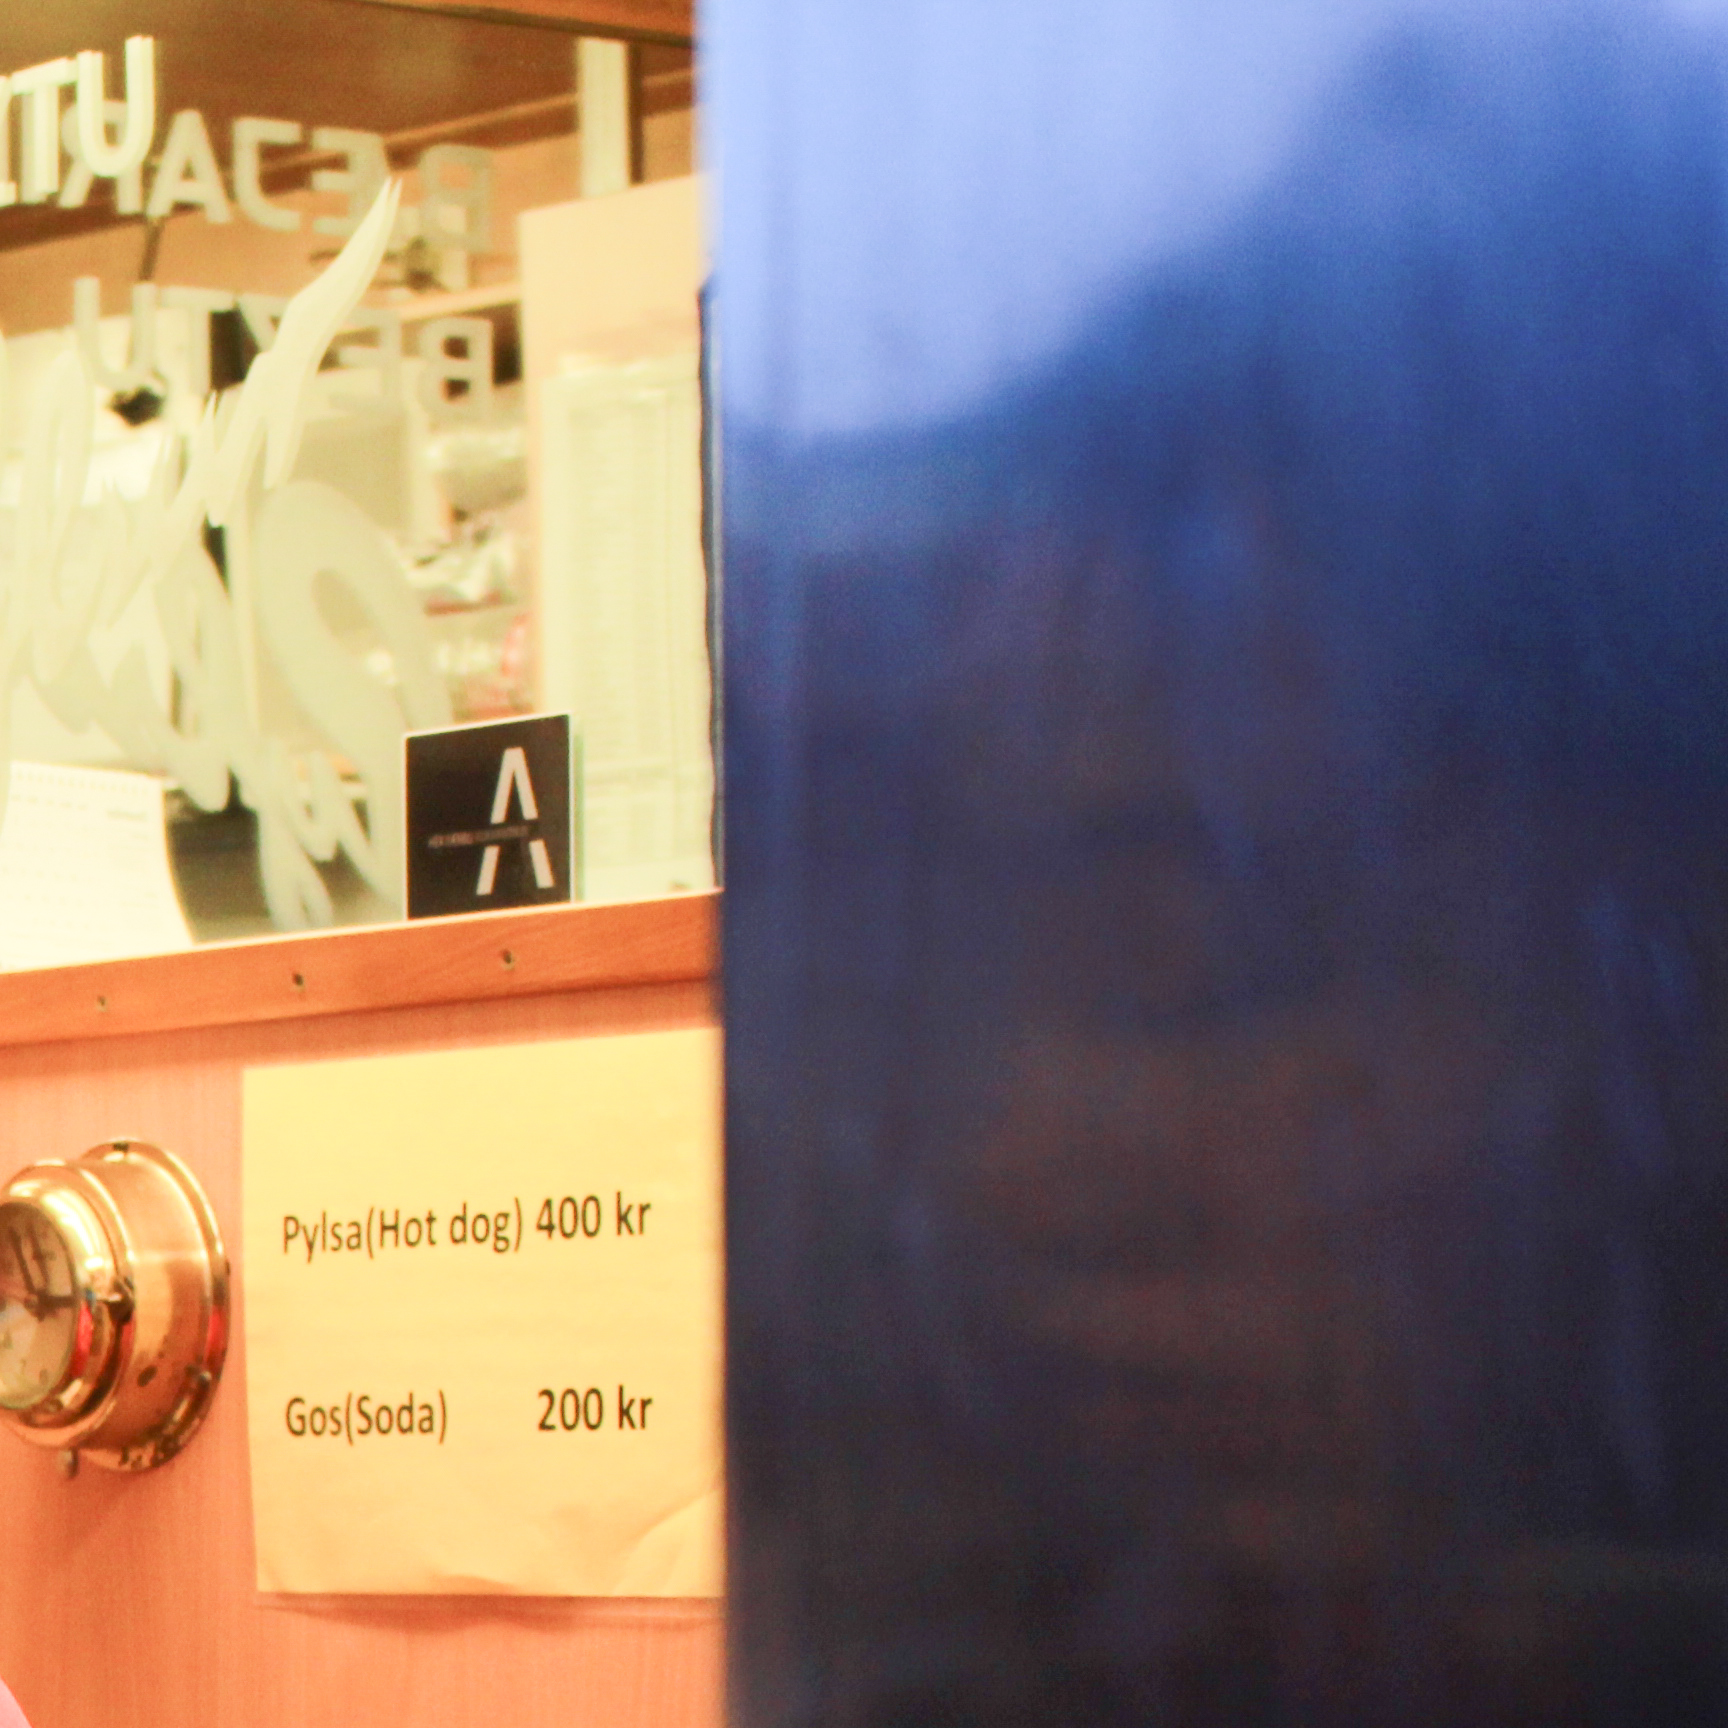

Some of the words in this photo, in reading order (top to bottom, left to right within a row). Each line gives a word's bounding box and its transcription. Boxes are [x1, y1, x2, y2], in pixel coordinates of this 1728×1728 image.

[283, 1207, 437, 1264] Pylsa(Hot
[449, 1197, 522, 1254] dog)
[536, 1195, 601, 1239] 400
[616, 1191, 651, 1235] kr
[285, 1390, 446, 1445] Gos(Soda)
[537, 1388, 604, 1432] 200
[617, 1385, 652, 1430] kr
